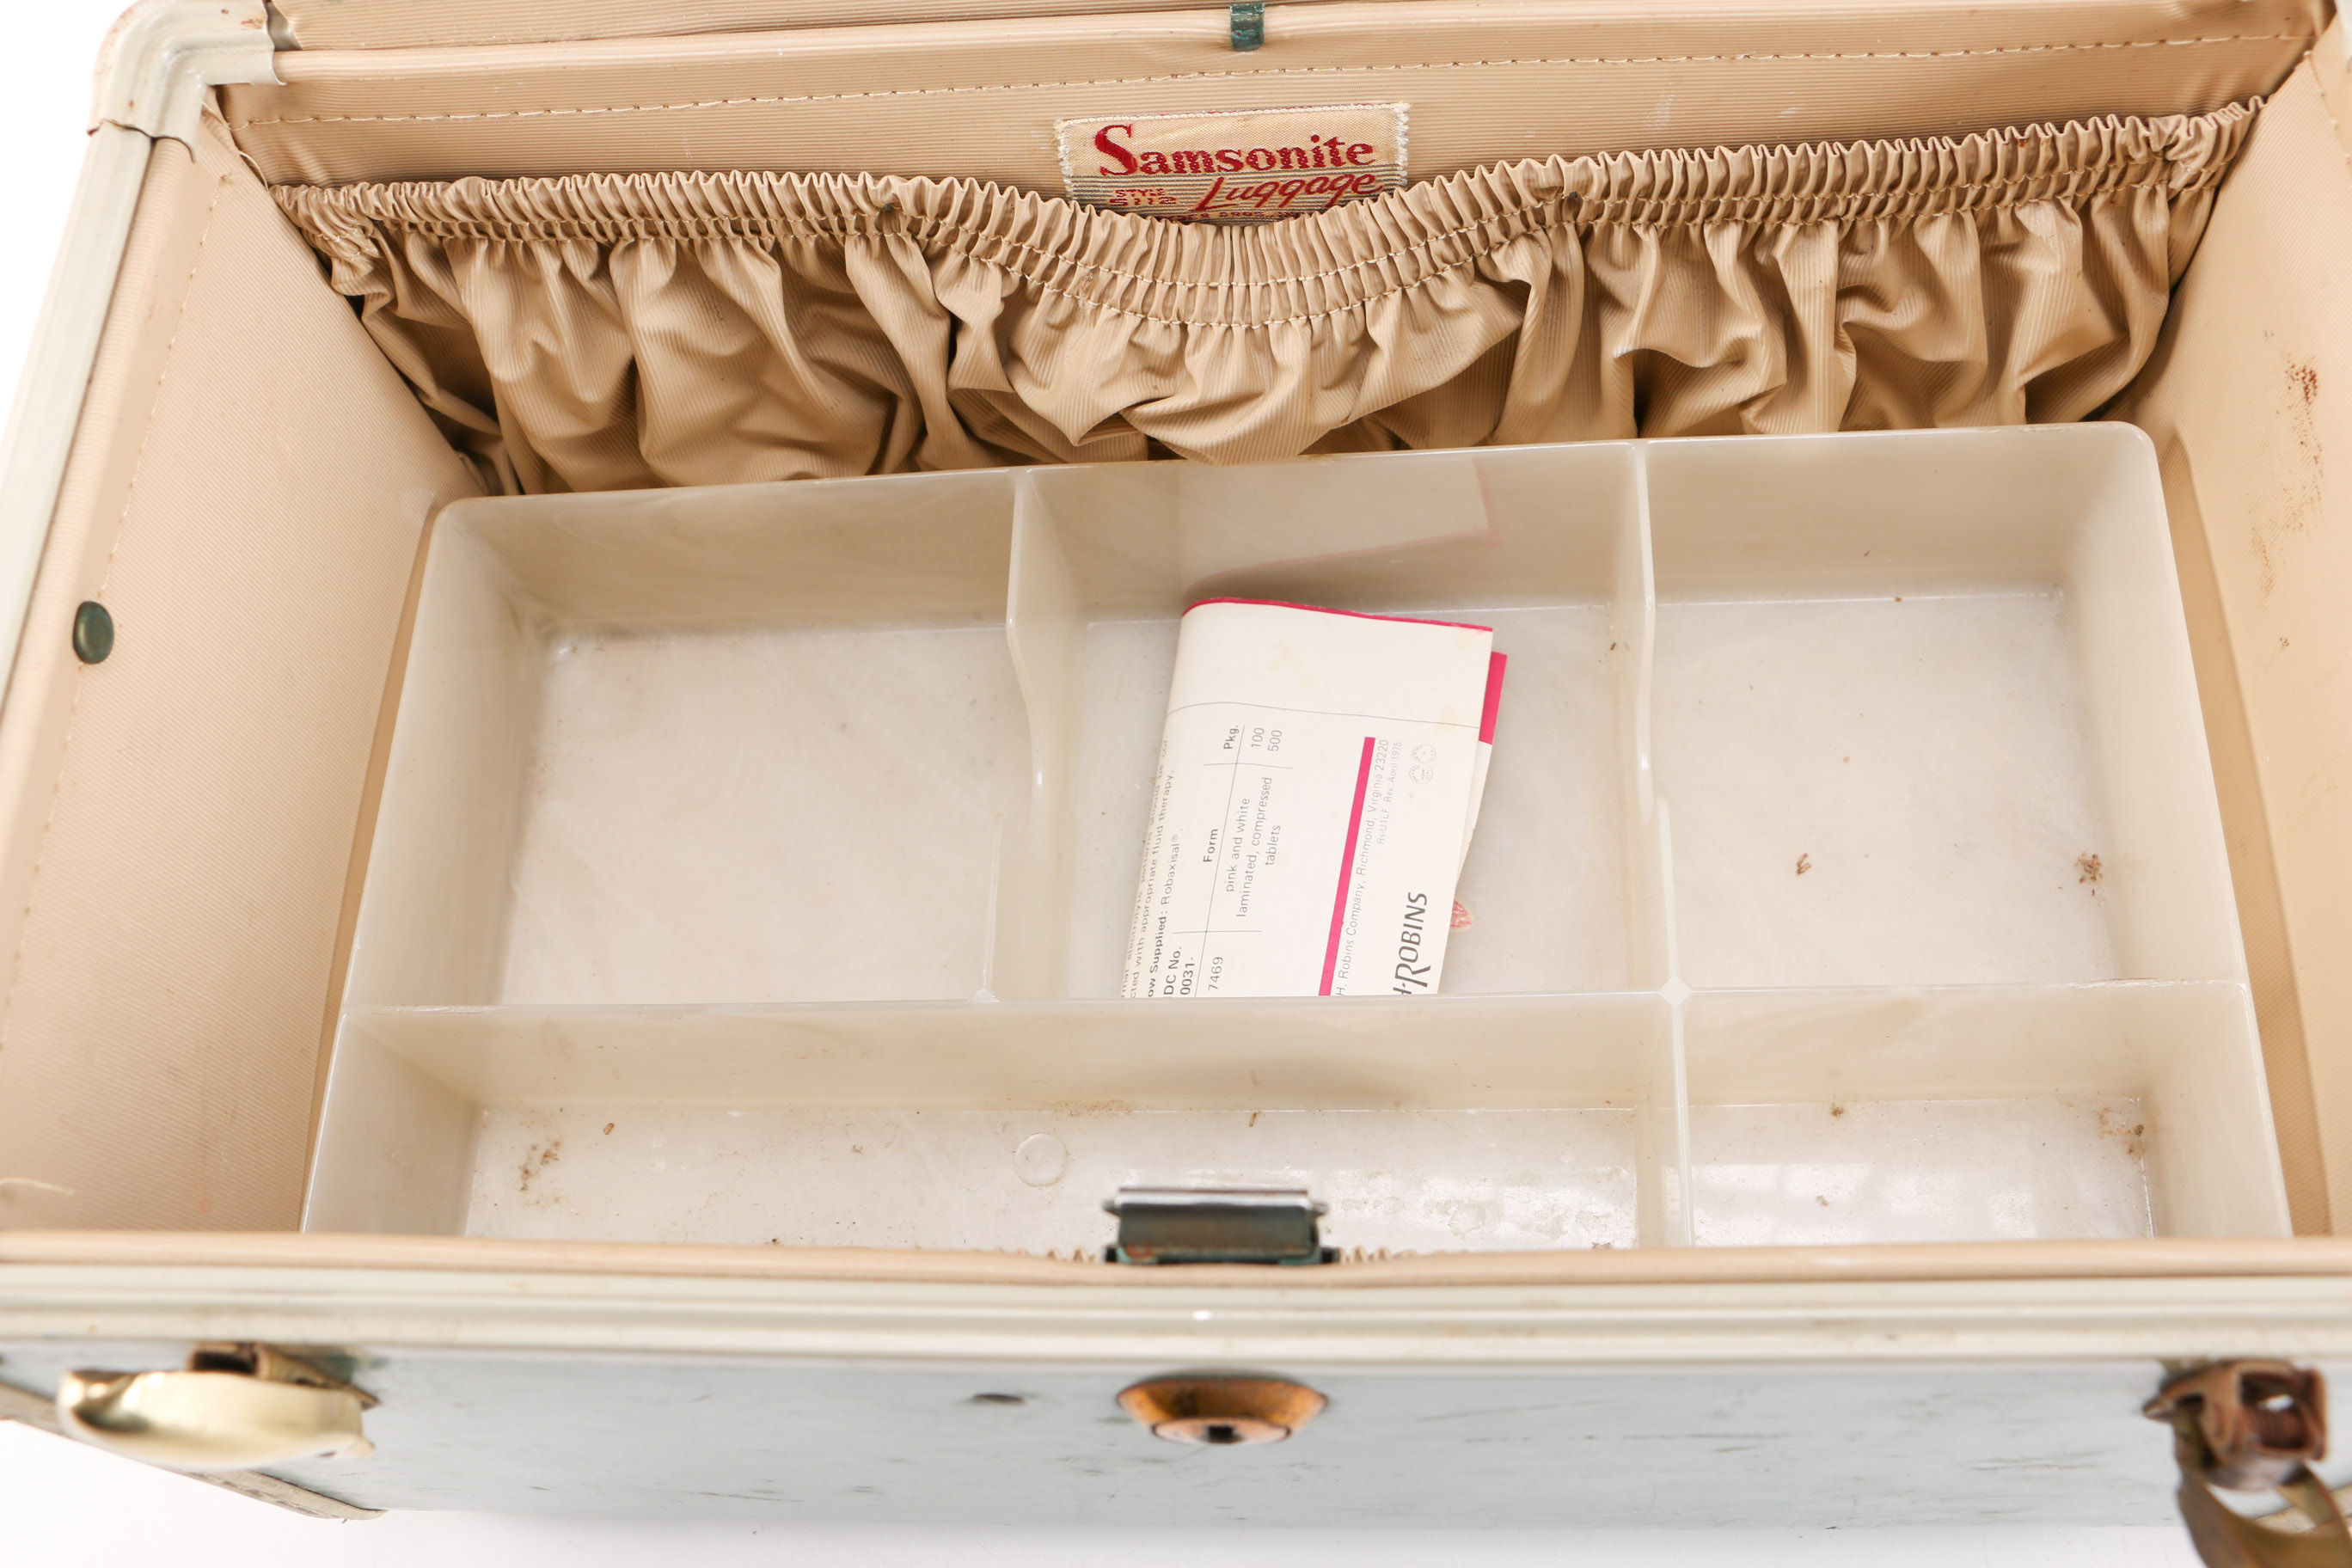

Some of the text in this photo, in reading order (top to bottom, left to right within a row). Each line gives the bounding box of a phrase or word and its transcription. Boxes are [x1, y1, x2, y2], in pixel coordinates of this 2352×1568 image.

[1093, 124, 1376, 176] Samsonite
[1115, 188, 1165, 198] STYLE
[1189, 173, 1383, 212] Luggage
[1223, 725, 1239, 750] Pkg.
[1251, 727, 1265, 748] 100
[1268, 730, 1283, 752] 500
[1375, 740, 1389, 770] 23220
[1368, 770, 1383, 813] Virginia
[1204, 828, 1218, 862] Form
[1225, 798, 1250, 892] pink and white
[1236, 776, 1272, 917] laminated, compressed
[1265, 824, 1281, 866] tablets
[1357, 818, 1375, 875] Richmond,
[1136, 937, 1146, 967] with
[1141, 858, 1158, 932] appropriate
[1153, 825, 1164, 854] fluid
[1159, 769, 1174, 820] therapy.
[1346, 879, 1366, 935] Company,
[1150, 911, 1167, 973] Supplied:
[1338, 940, 1355, 979] Robins
[1163, 946, 1181, 997] DC No.
[1209, 957, 1223, 990] 7469
